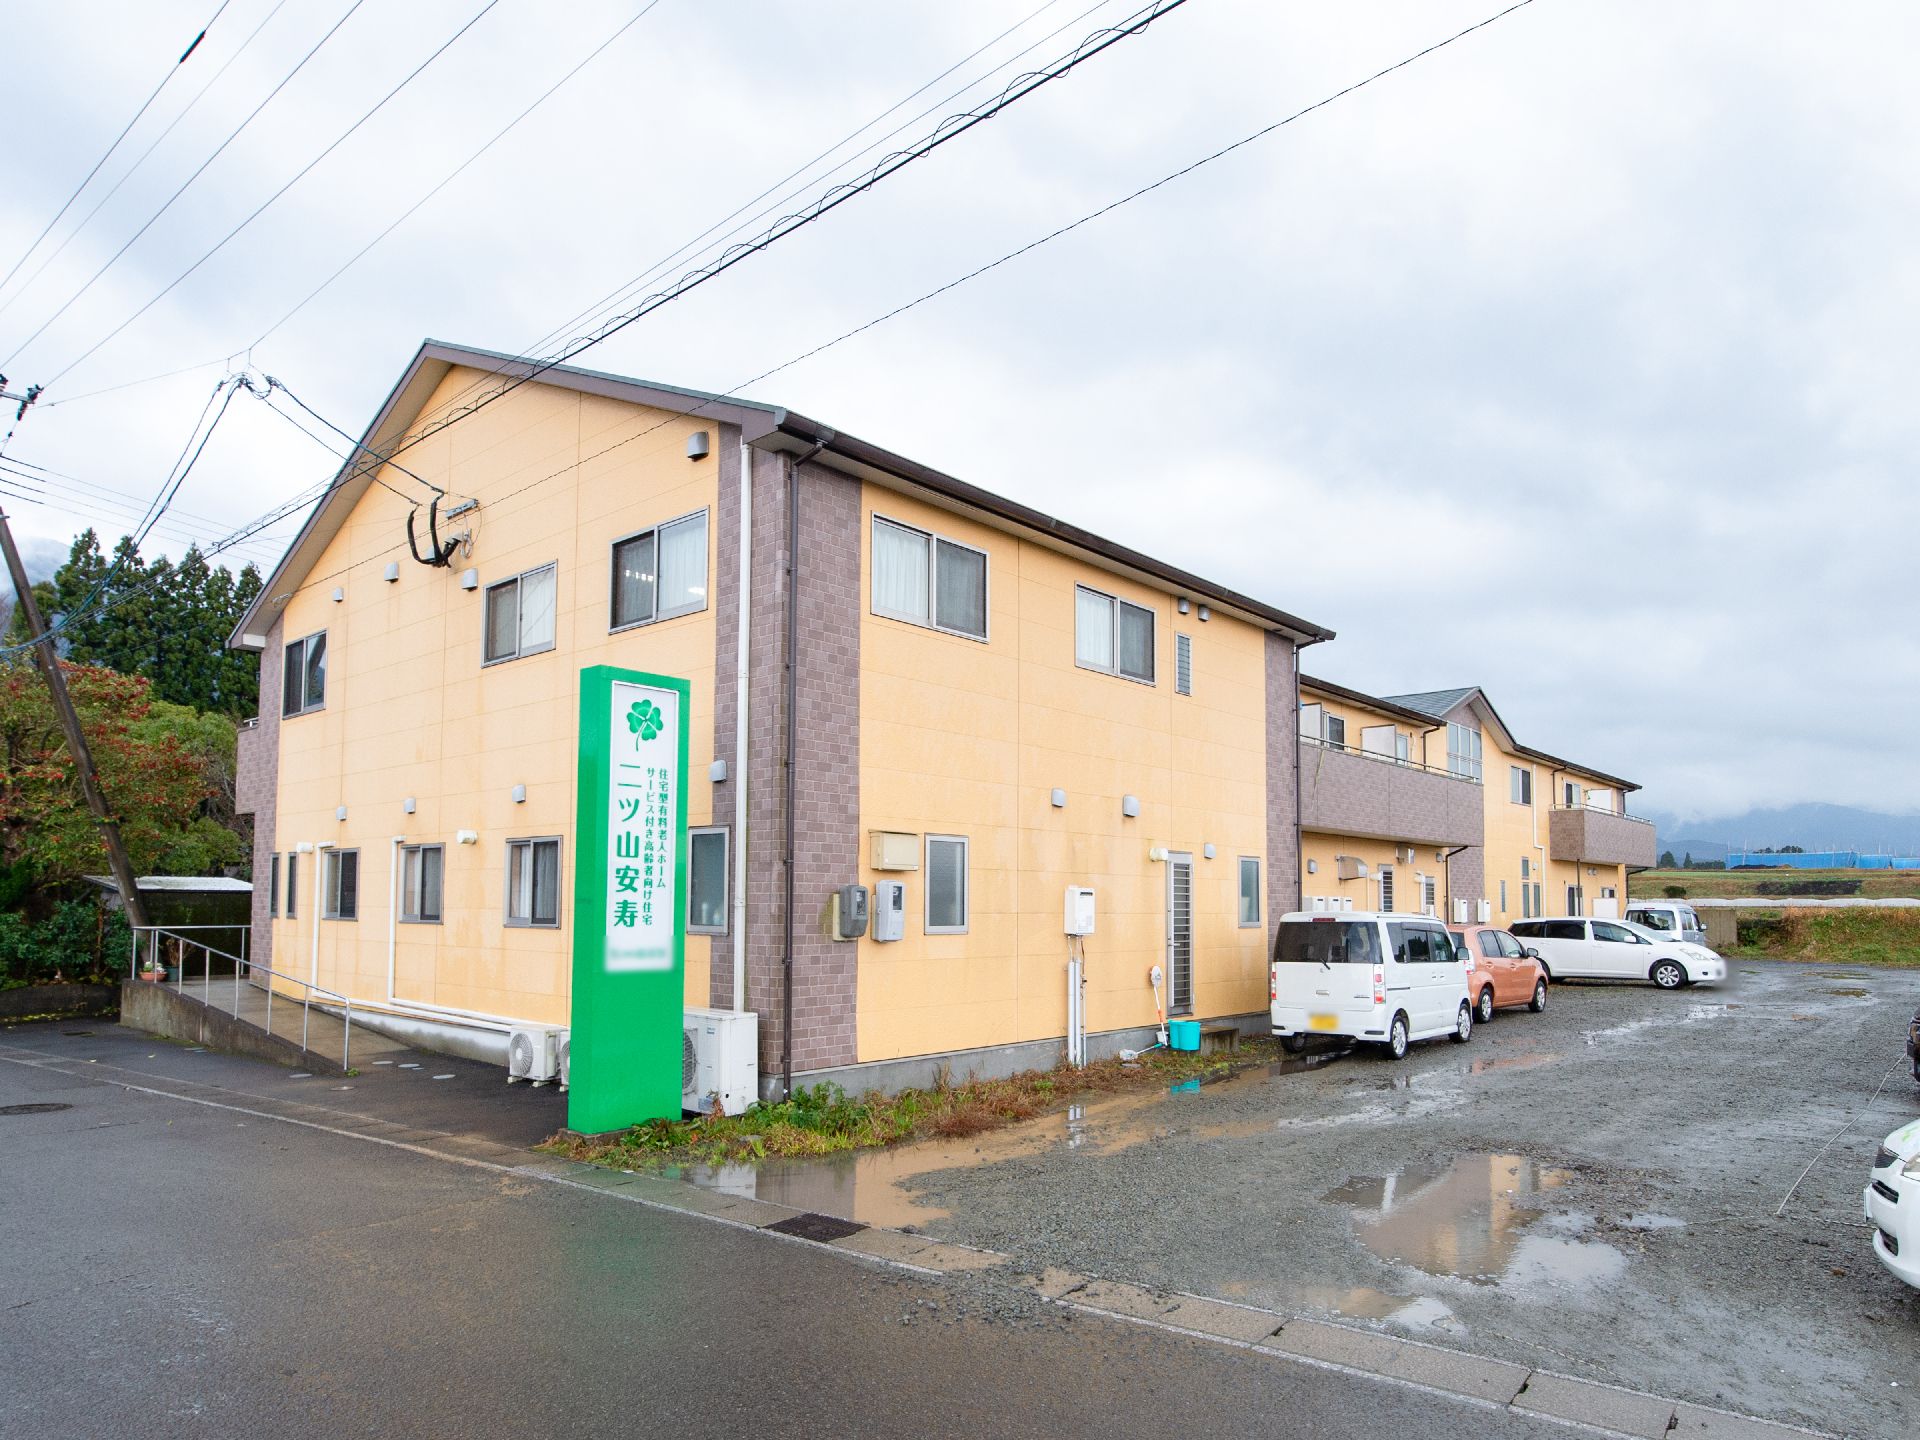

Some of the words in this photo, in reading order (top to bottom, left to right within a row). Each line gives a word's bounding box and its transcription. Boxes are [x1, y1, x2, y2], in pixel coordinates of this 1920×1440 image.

[614, 763, 642, 927] 二ツ山安寿
[642, 767, 655, 925] サービス付き高齢者向け住宅
[656, 768, 668, 888] 住宅型有料老人ホーム
